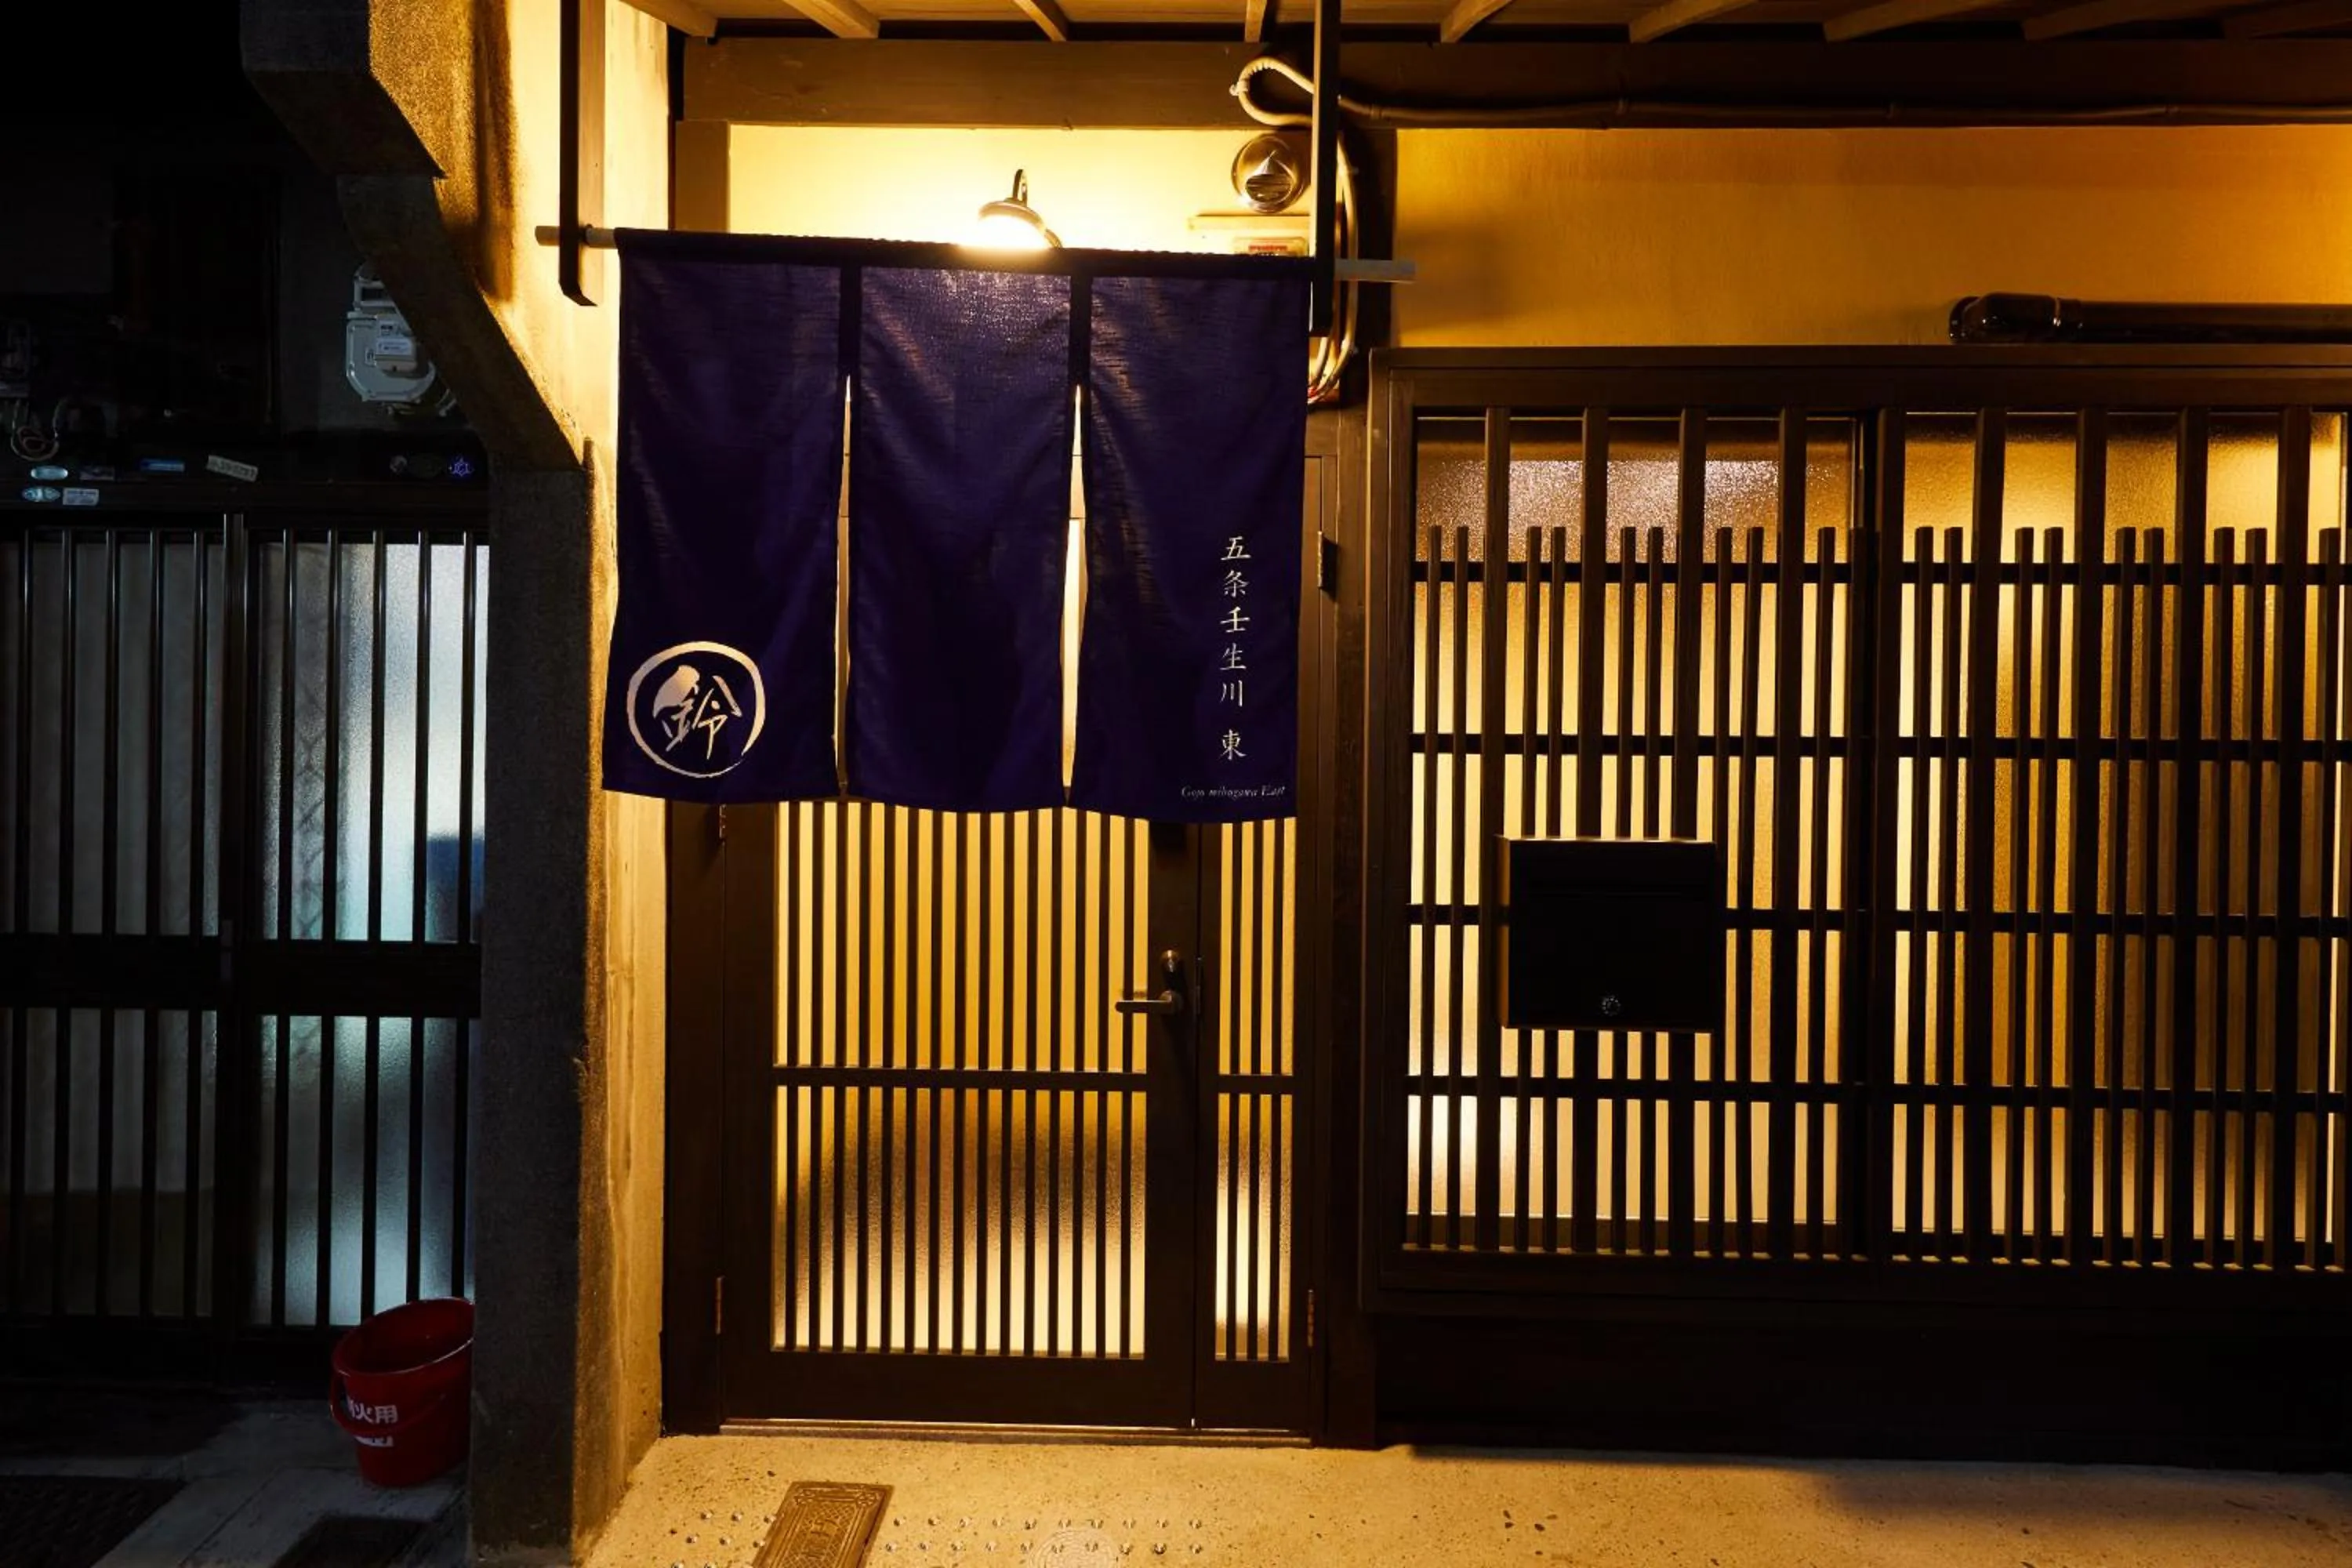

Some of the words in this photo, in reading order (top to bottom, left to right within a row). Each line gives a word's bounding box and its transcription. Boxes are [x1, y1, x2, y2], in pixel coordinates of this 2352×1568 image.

[1220, 536, 1251, 707] 五条壬生川
[1220, 729, 1247, 760] 東
